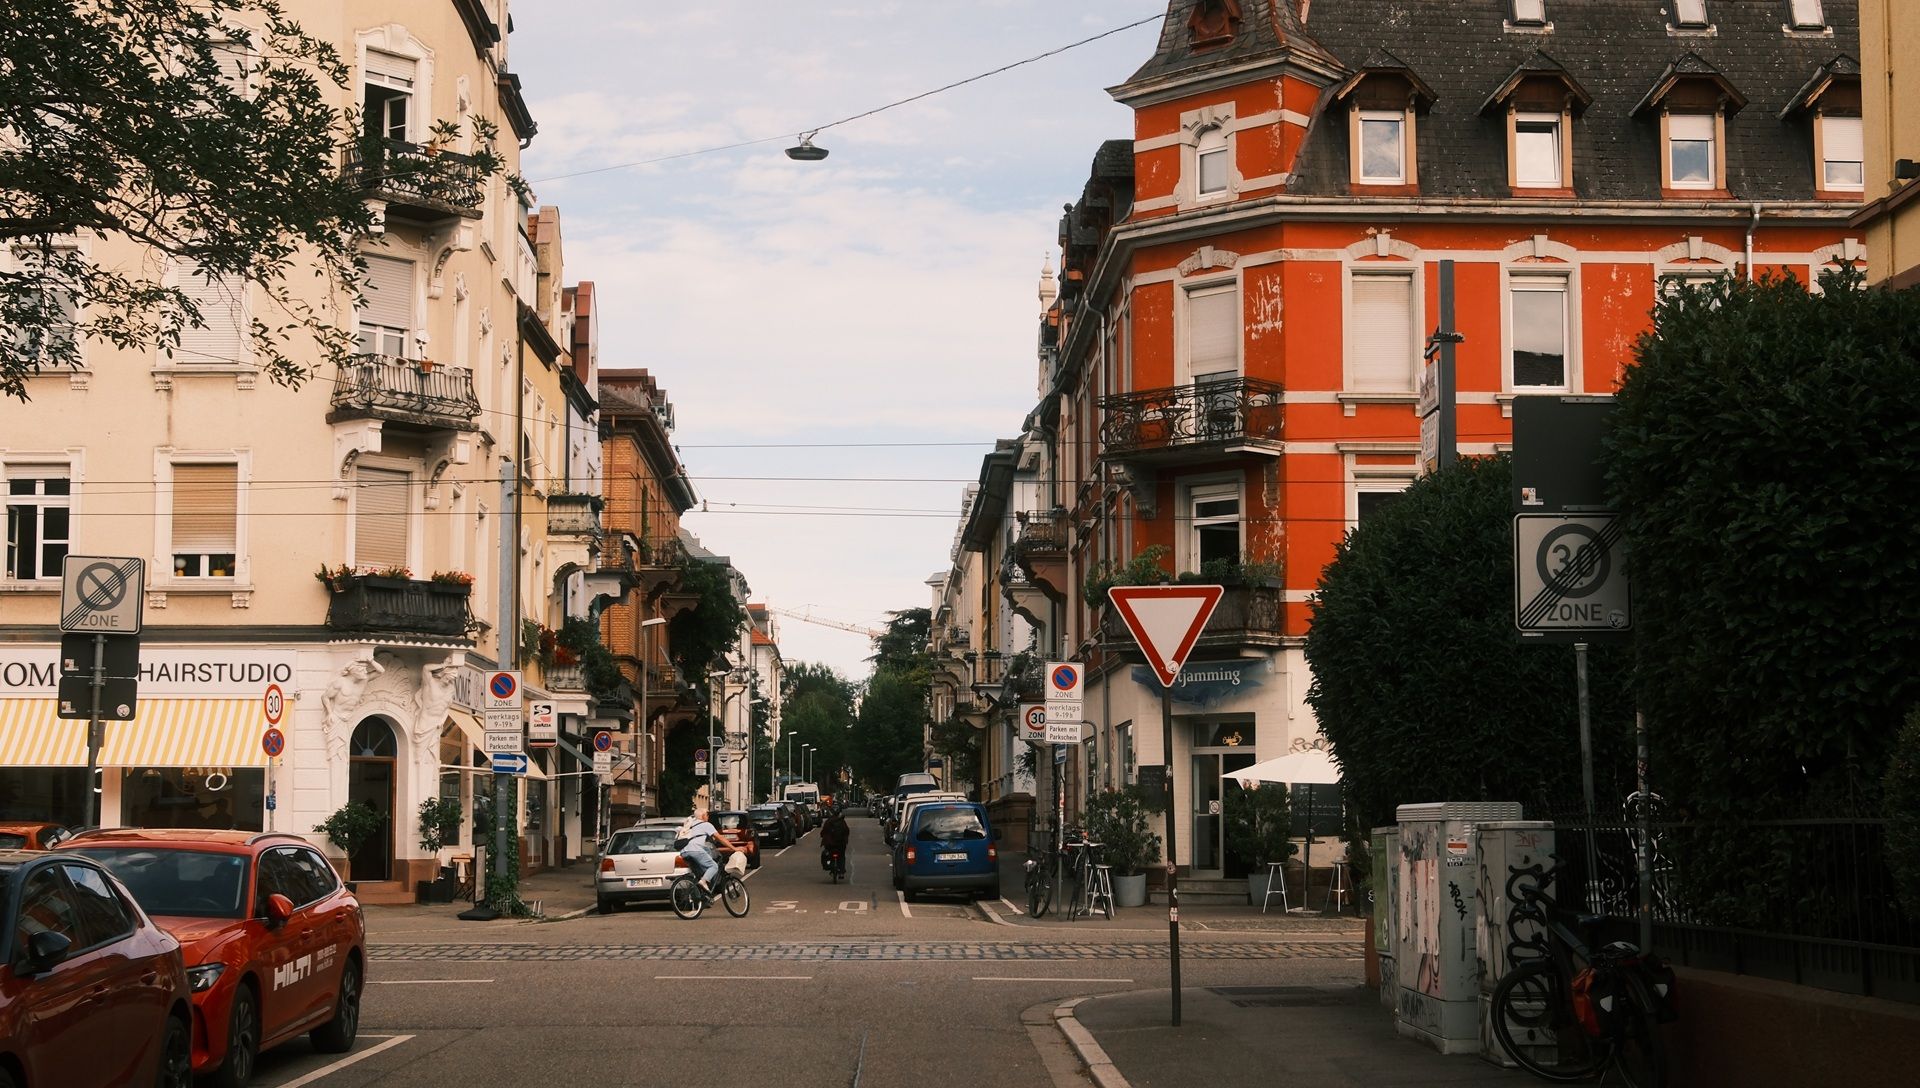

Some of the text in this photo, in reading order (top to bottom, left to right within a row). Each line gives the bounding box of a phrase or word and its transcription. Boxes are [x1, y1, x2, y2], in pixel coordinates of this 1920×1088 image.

[1552, 543, 1595, 578] 30
[80, 614, 119, 627] ZONE
[1547, 603, 1603, 621] ZONE
[0, 662, 57, 687] OM
[138, 662, 292, 683] HAIRSTUDIO
[1177, 667, 1241, 688] tjamming
[268, 695, 280, 714] 30
[1048, 704, 1081, 713] werktags
[487, 713, 520, 721] werktags
[1031, 712, 1045, 724] 30
[1049, 733, 1078, 741] Parkschein
[273, 954, 311, 991] HILTI
